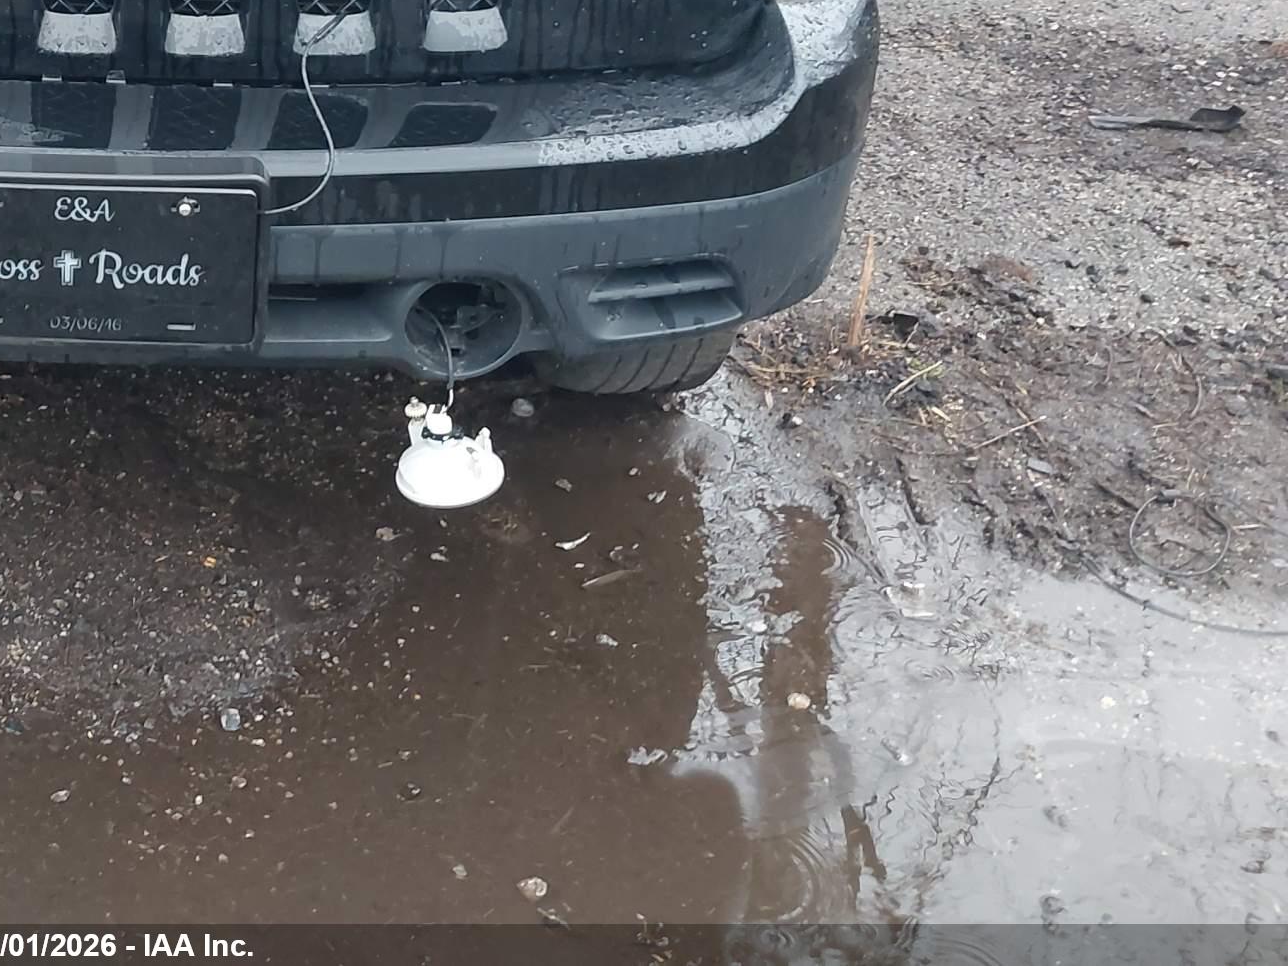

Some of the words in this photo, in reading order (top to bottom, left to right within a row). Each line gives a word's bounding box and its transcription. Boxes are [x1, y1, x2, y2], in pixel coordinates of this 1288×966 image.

[54, 196, 116, 222] E&A
[89, 248, 205, 290] Roads
[49, 315, 123, 333] 03/06/16
